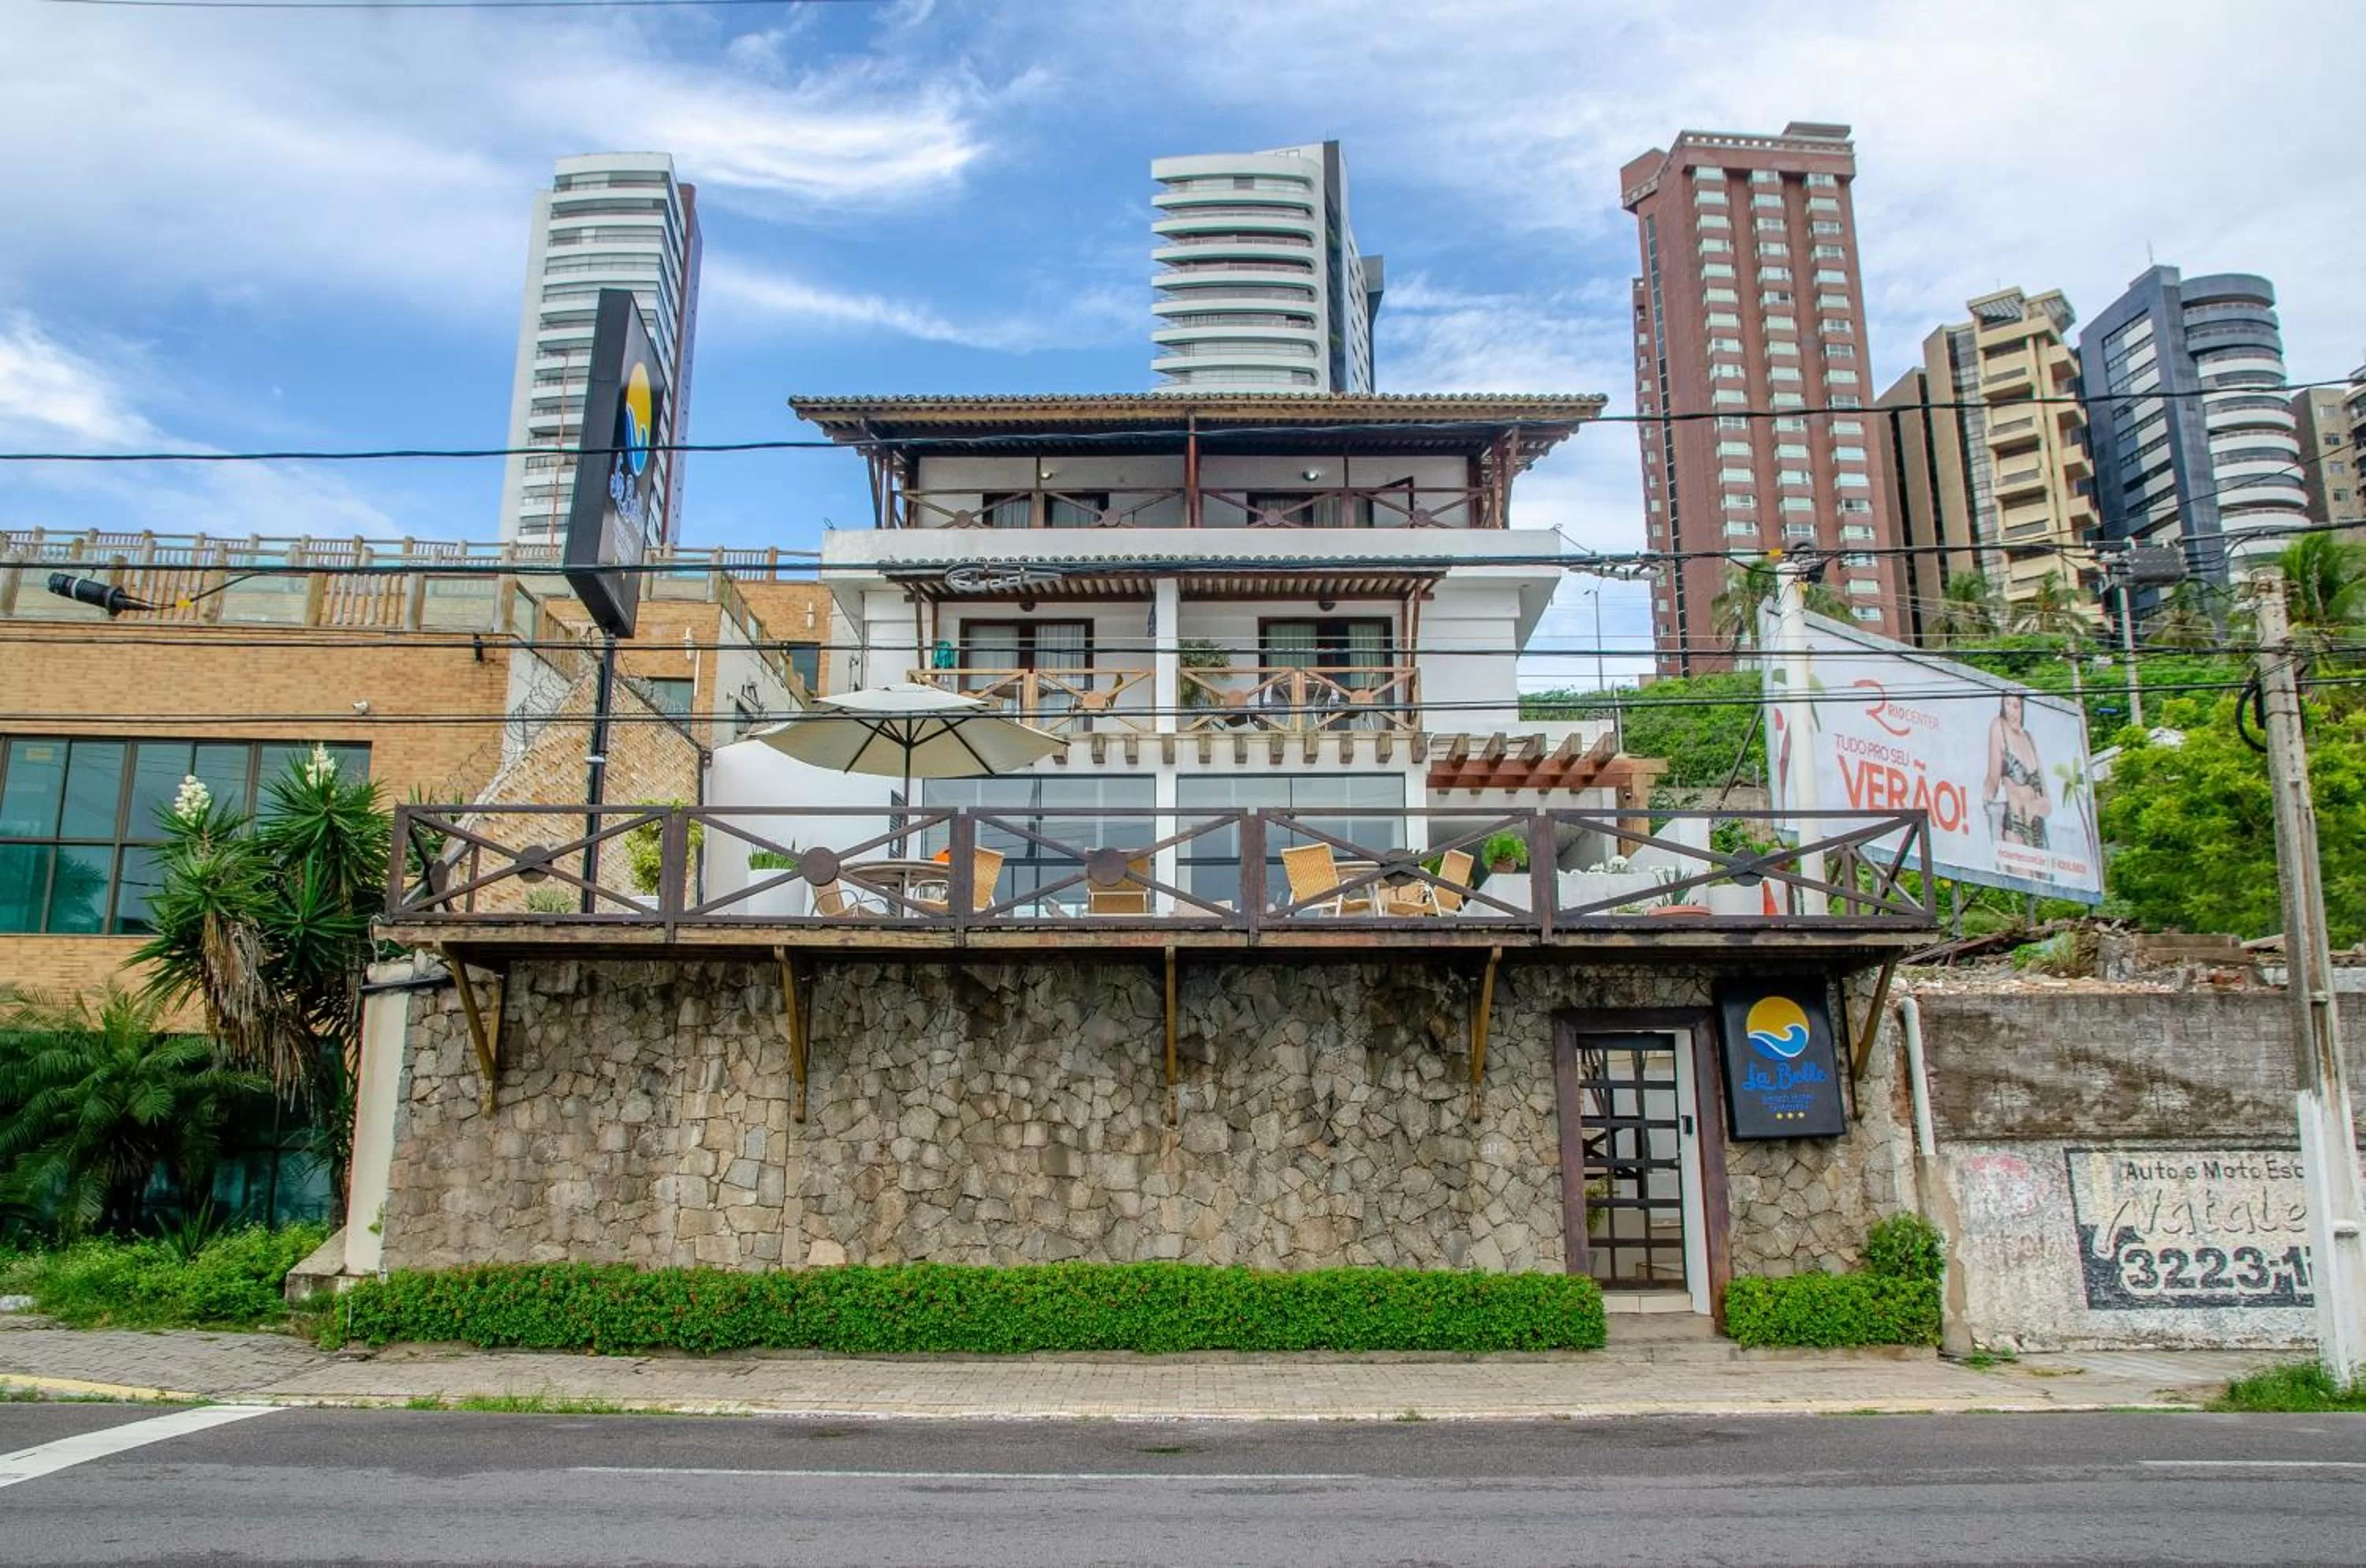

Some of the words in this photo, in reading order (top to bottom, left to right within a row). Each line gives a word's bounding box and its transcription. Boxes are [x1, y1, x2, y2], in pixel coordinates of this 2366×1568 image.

[1834, 733, 1866, 755] TUDO
[1867, 742, 1889, 762] PRO
[1890, 748, 1910, 767] SEU
[1837, 754, 1969, 835] VERÃO!
[2126, 1160, 2177, 1180] Auto
[2185, 1166, 2198, 1180] e
[2203, 1159, 2260, 1180] Moto
[2124, 1245, 2313, 1290] 3223-1
